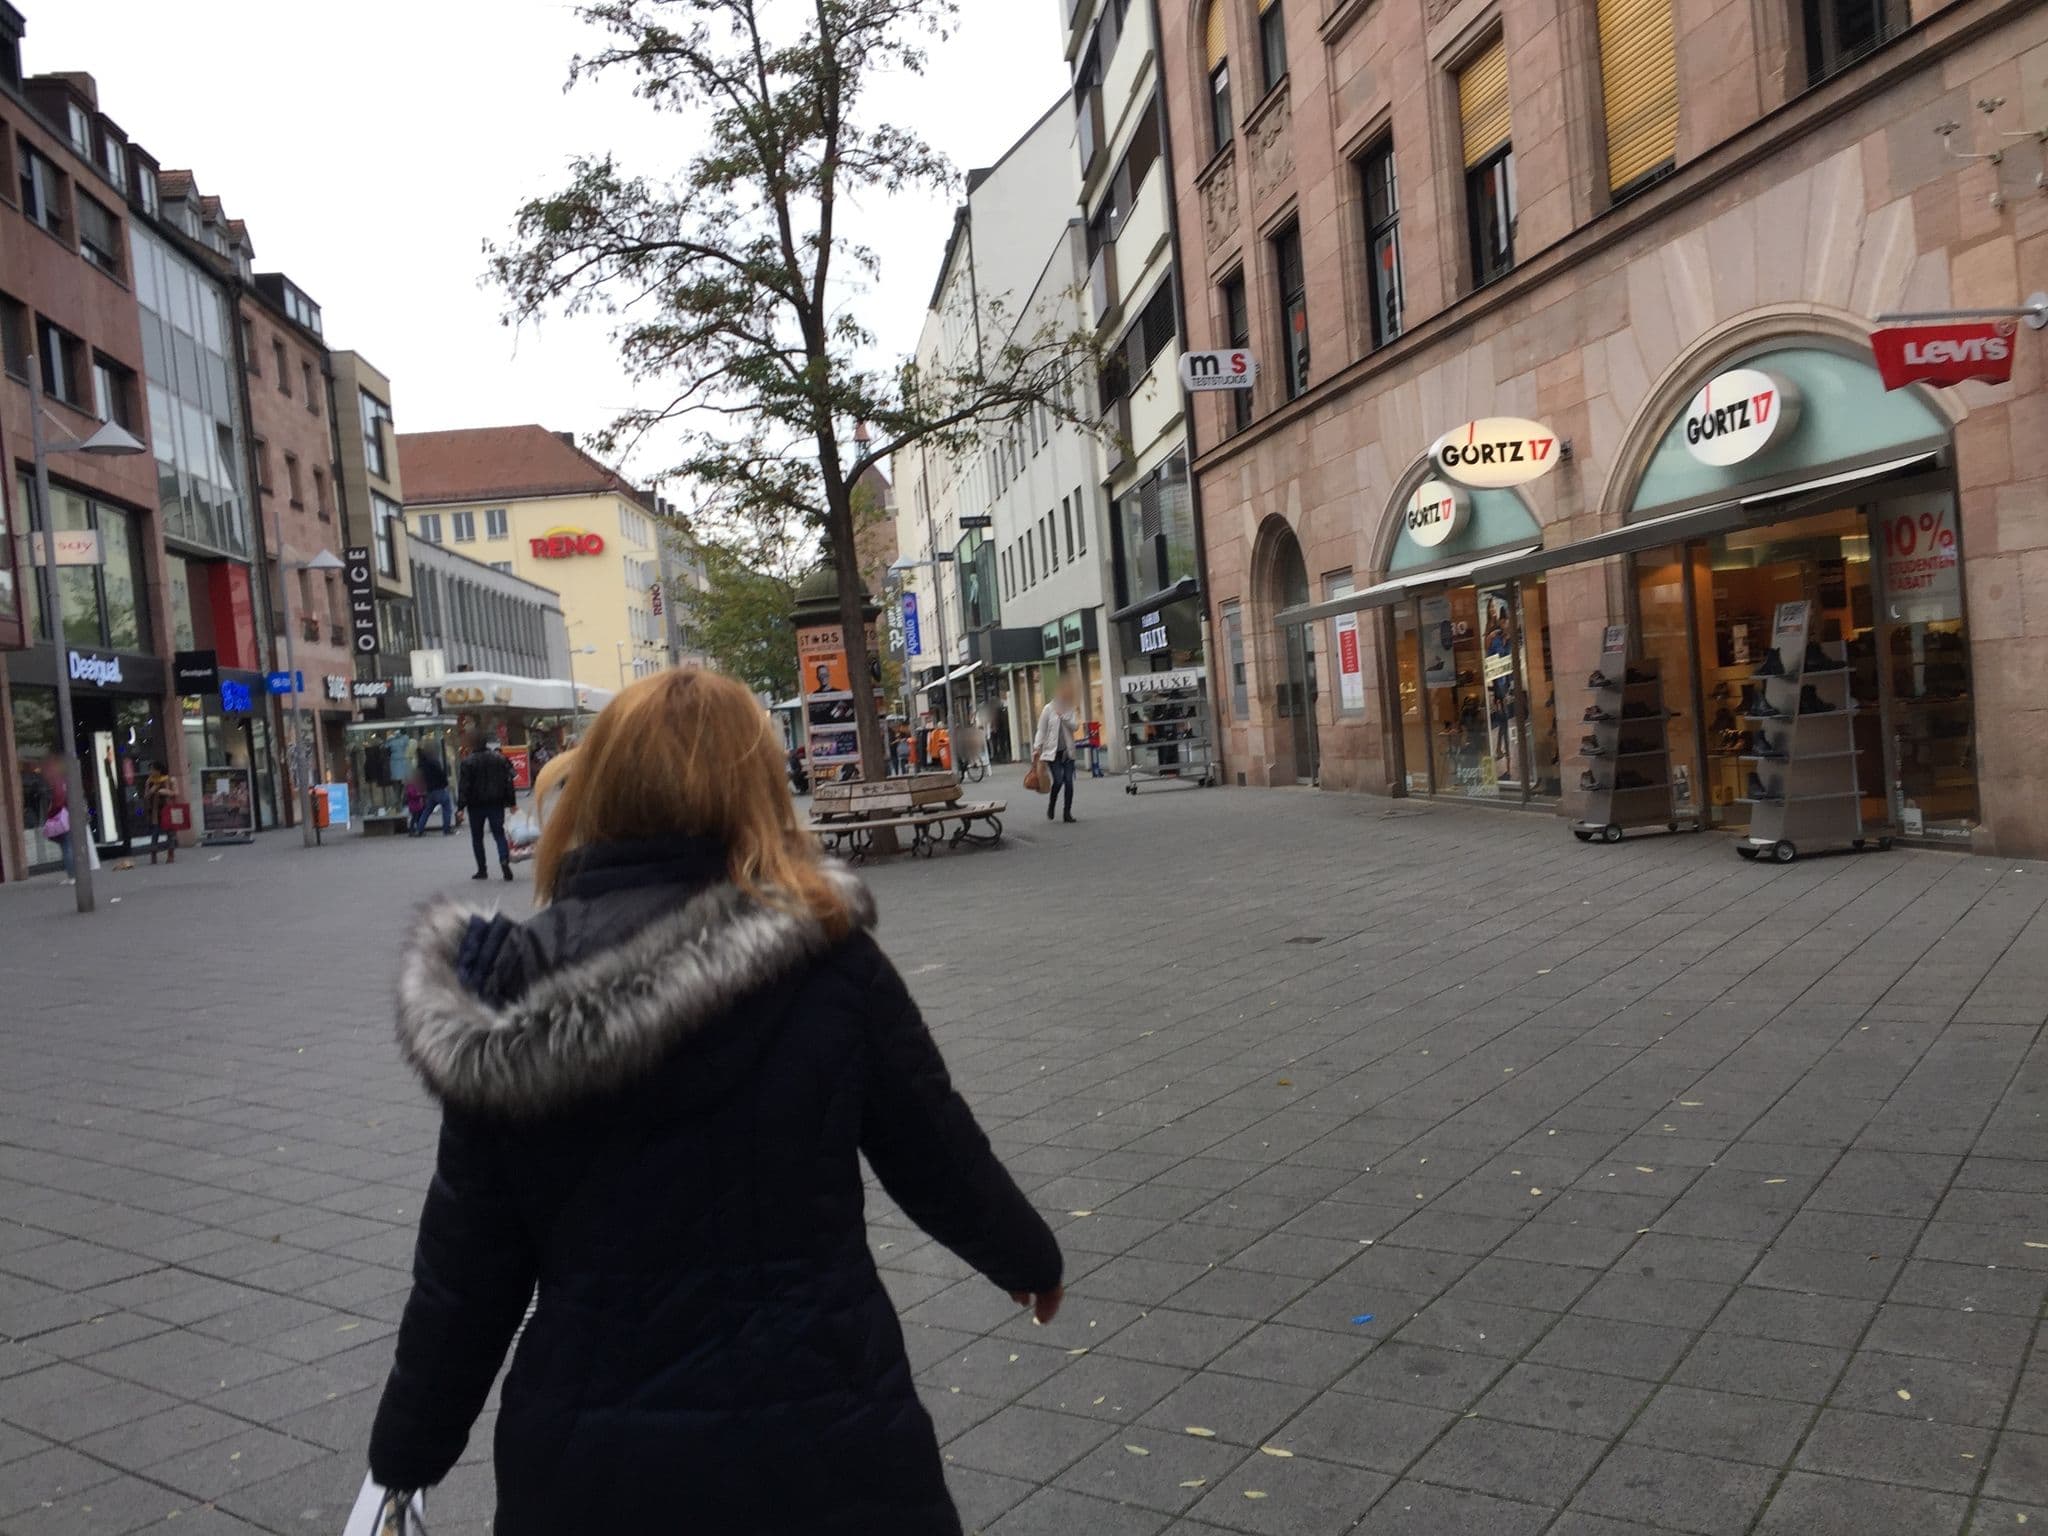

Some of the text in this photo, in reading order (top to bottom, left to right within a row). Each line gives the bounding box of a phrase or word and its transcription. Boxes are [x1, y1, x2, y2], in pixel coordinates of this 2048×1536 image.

[1752, 390, 1774, 424] 17
[1528, 438, 1554, 461] 17
[1441, 498, 1452, 521] 17
[529, 533, 605, 559] RENO
[1882, 510, 1953, 558] 10%
[349, 550, 375, 650] OFFICE
[650, 583, 662, 616] RENO
[905, 618, 918, 655] Apollo
[1127, 675, 1193, 693] DELUXE
